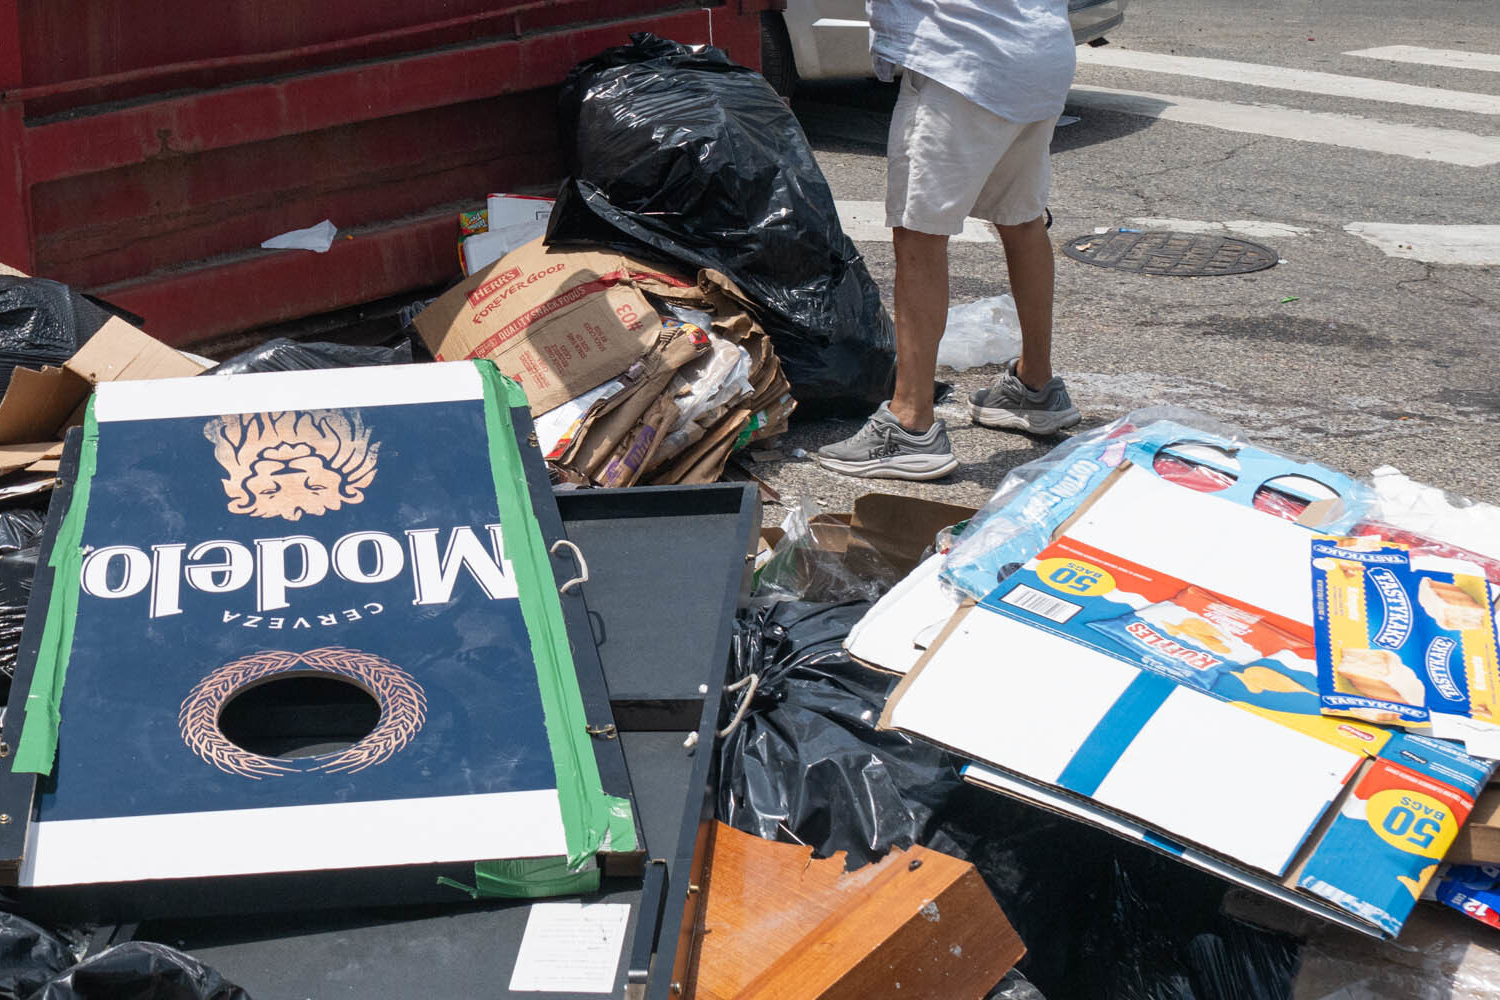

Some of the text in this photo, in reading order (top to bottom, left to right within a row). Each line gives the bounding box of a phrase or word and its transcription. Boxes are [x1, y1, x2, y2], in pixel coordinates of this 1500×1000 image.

[472, 263, 565, 325] FOREVER GOOD
[499, 315, 532, 342] QUALITY
[530, 300, 560, 321] SNACK
[80, 524, 519, 619] Modelo
[1067, 562, 1103, 578] BAGS
[1314, 544, 1405, 564] TASTYKAKE
[1049, 567, 1099, 592] 50
[222, 600, 385, 630] CERVEZA
[1374, 571, 1410, 648] TASTYKAKE
[1126, 622, 1221, 670] RUFFLES
[1428, 637, 1461, 698] TASTYKAKE
[1326, 695, 1422, 718] TASTYKAKE
[1382, 805, 1441, 849] 50
[1400, 796, 1446, 822] BAGS
[1462, 897, 1489, 917] 12
